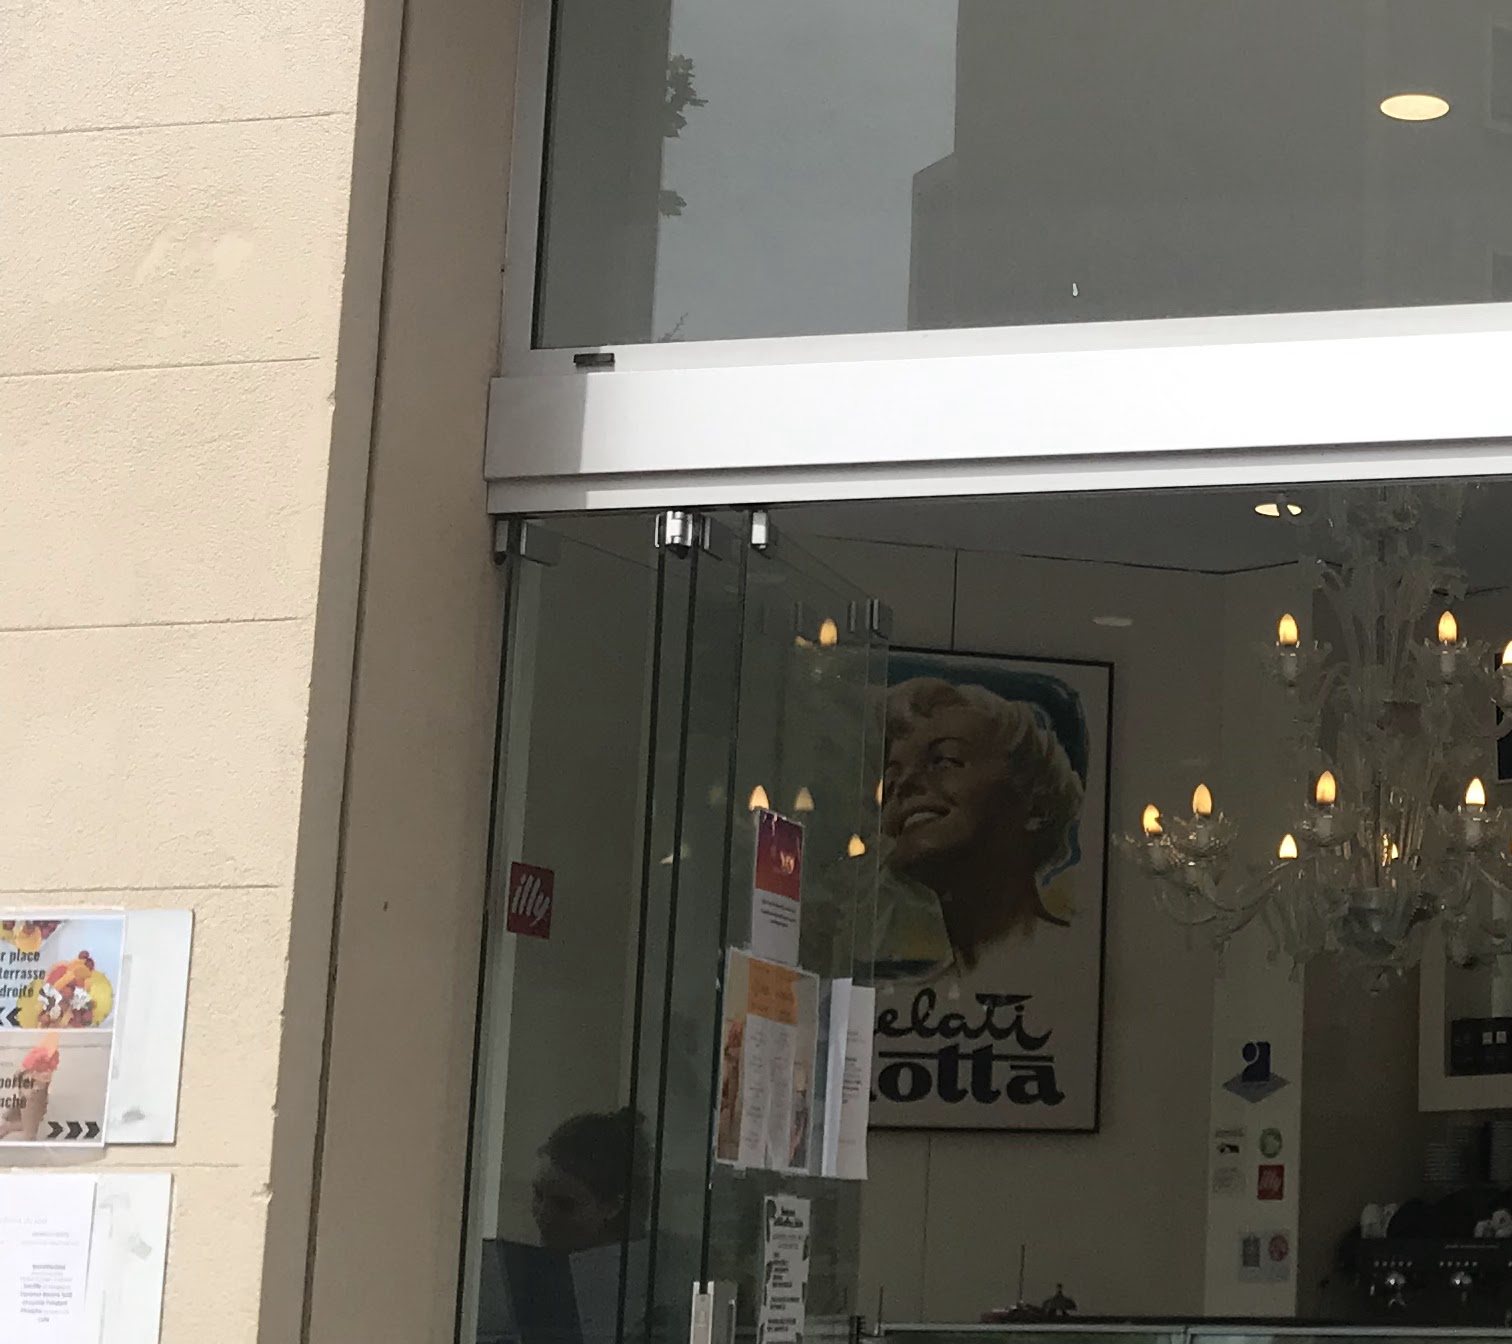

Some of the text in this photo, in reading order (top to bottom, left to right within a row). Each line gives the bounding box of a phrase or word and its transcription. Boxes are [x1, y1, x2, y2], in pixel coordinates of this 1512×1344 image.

[511, 873, 551, 928] illy
[9, 948, 41, 965] place
[0, 984, 34, 998] droite
[872, 988, 1054, 1052] elati
[869, 1043, 1066, 1106] otta
